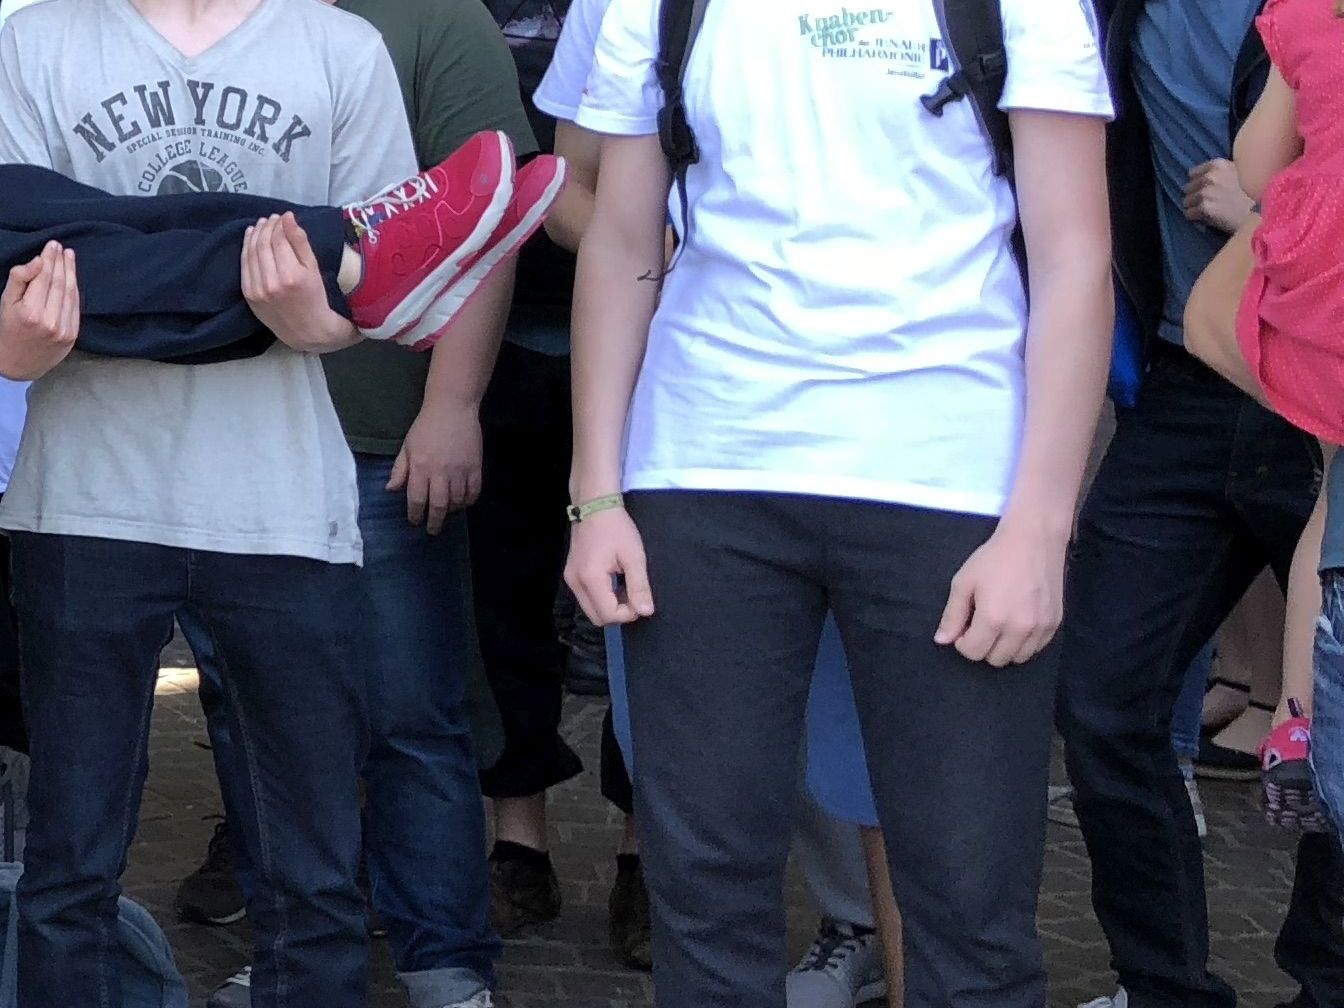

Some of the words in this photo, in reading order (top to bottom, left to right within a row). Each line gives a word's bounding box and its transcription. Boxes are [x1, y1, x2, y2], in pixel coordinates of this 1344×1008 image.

[72, 79, 177, 164] NEW
[186, 78, 313, 164] YORK
[126, 131, 163, 154] SPECIAL
[137, 139, 193, 194] COLLEGE
[198, 141, 249, 194] LEAGUE
